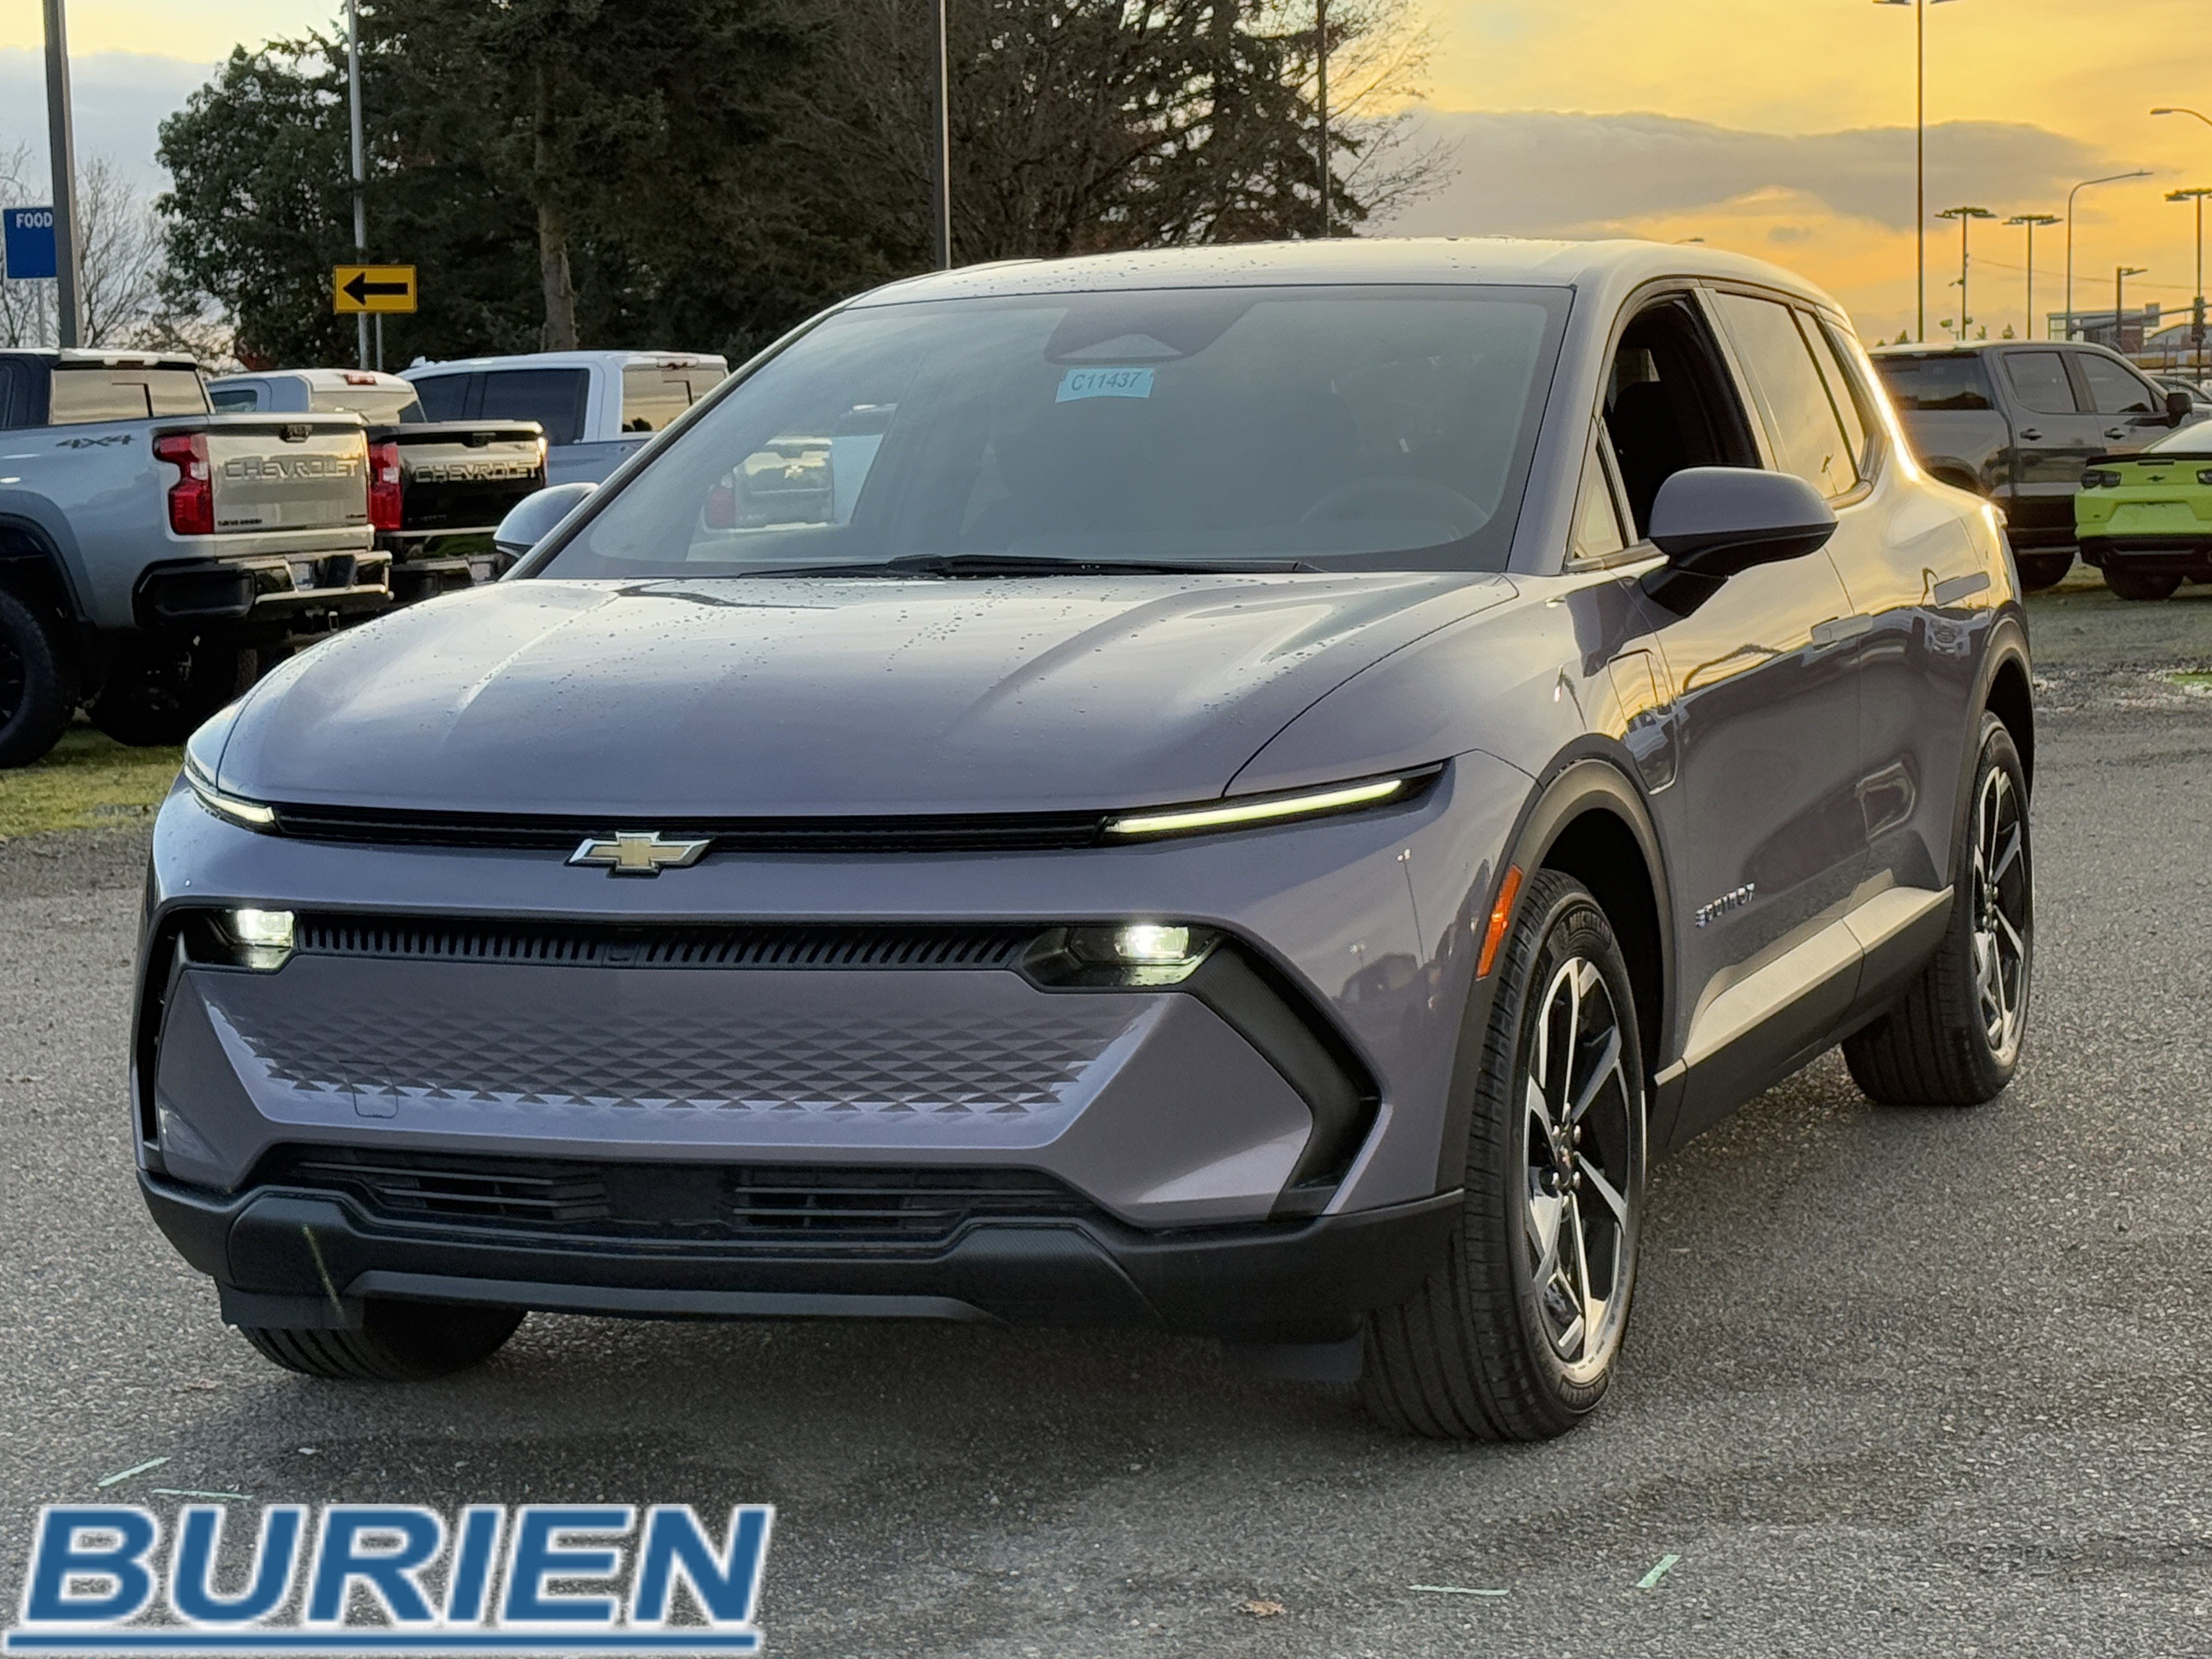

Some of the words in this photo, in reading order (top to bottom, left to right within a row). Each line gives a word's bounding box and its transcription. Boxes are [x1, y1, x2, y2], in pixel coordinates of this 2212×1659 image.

[16, 212, 53, 229] FOOD
[1071, 371, 1143, 391] C11437
[224, 459, 359, 481] CHEVROLET
[414, 464, 538, 483] CHEVROLET
